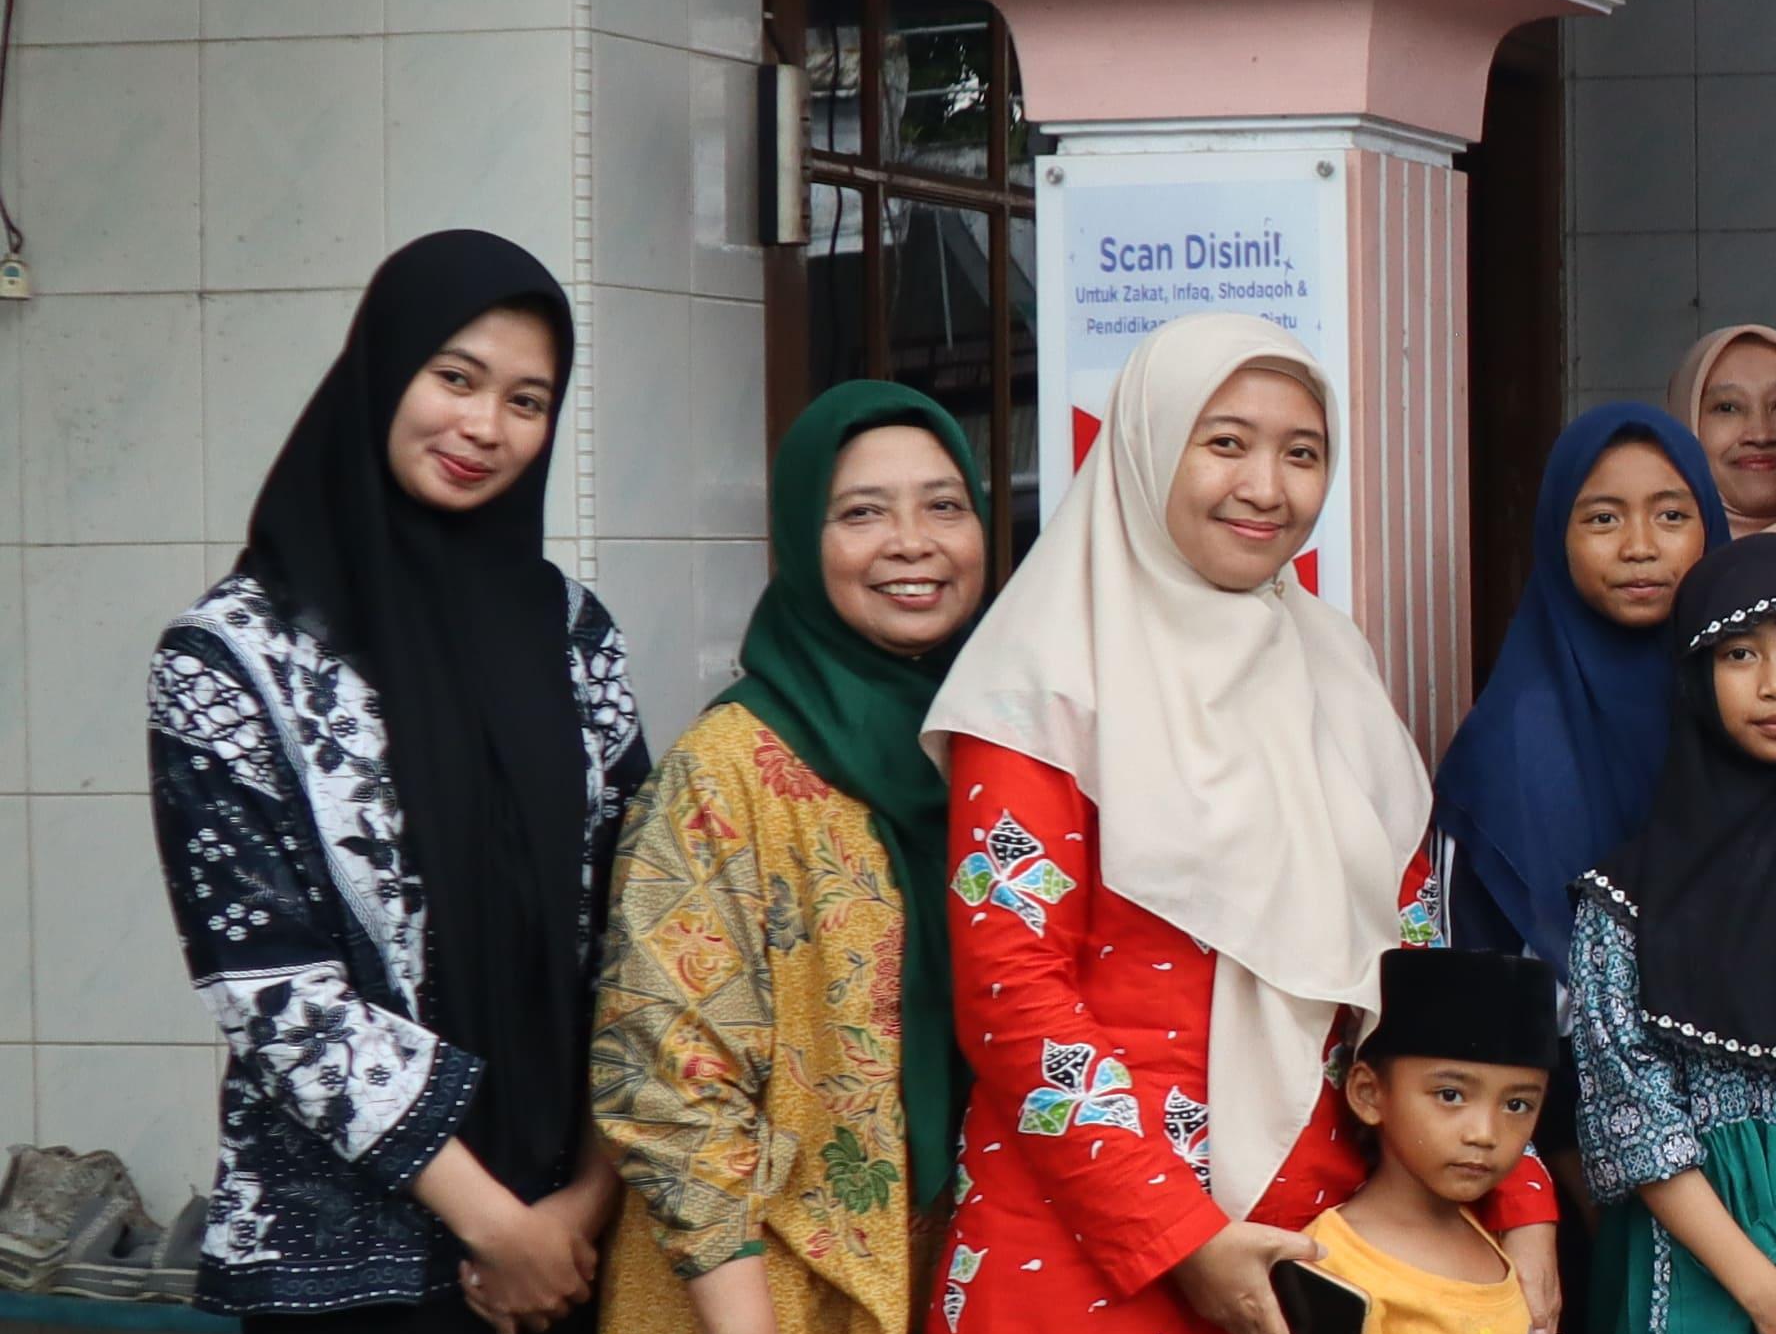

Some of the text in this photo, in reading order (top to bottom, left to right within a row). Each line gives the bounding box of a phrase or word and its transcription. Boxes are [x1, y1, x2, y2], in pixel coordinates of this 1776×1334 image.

[1099, 230, 1281, 273] Scan Disini!
[1075, 280, 1308, 304] Untuk Zakat, Infaq, Shodaqoh &
